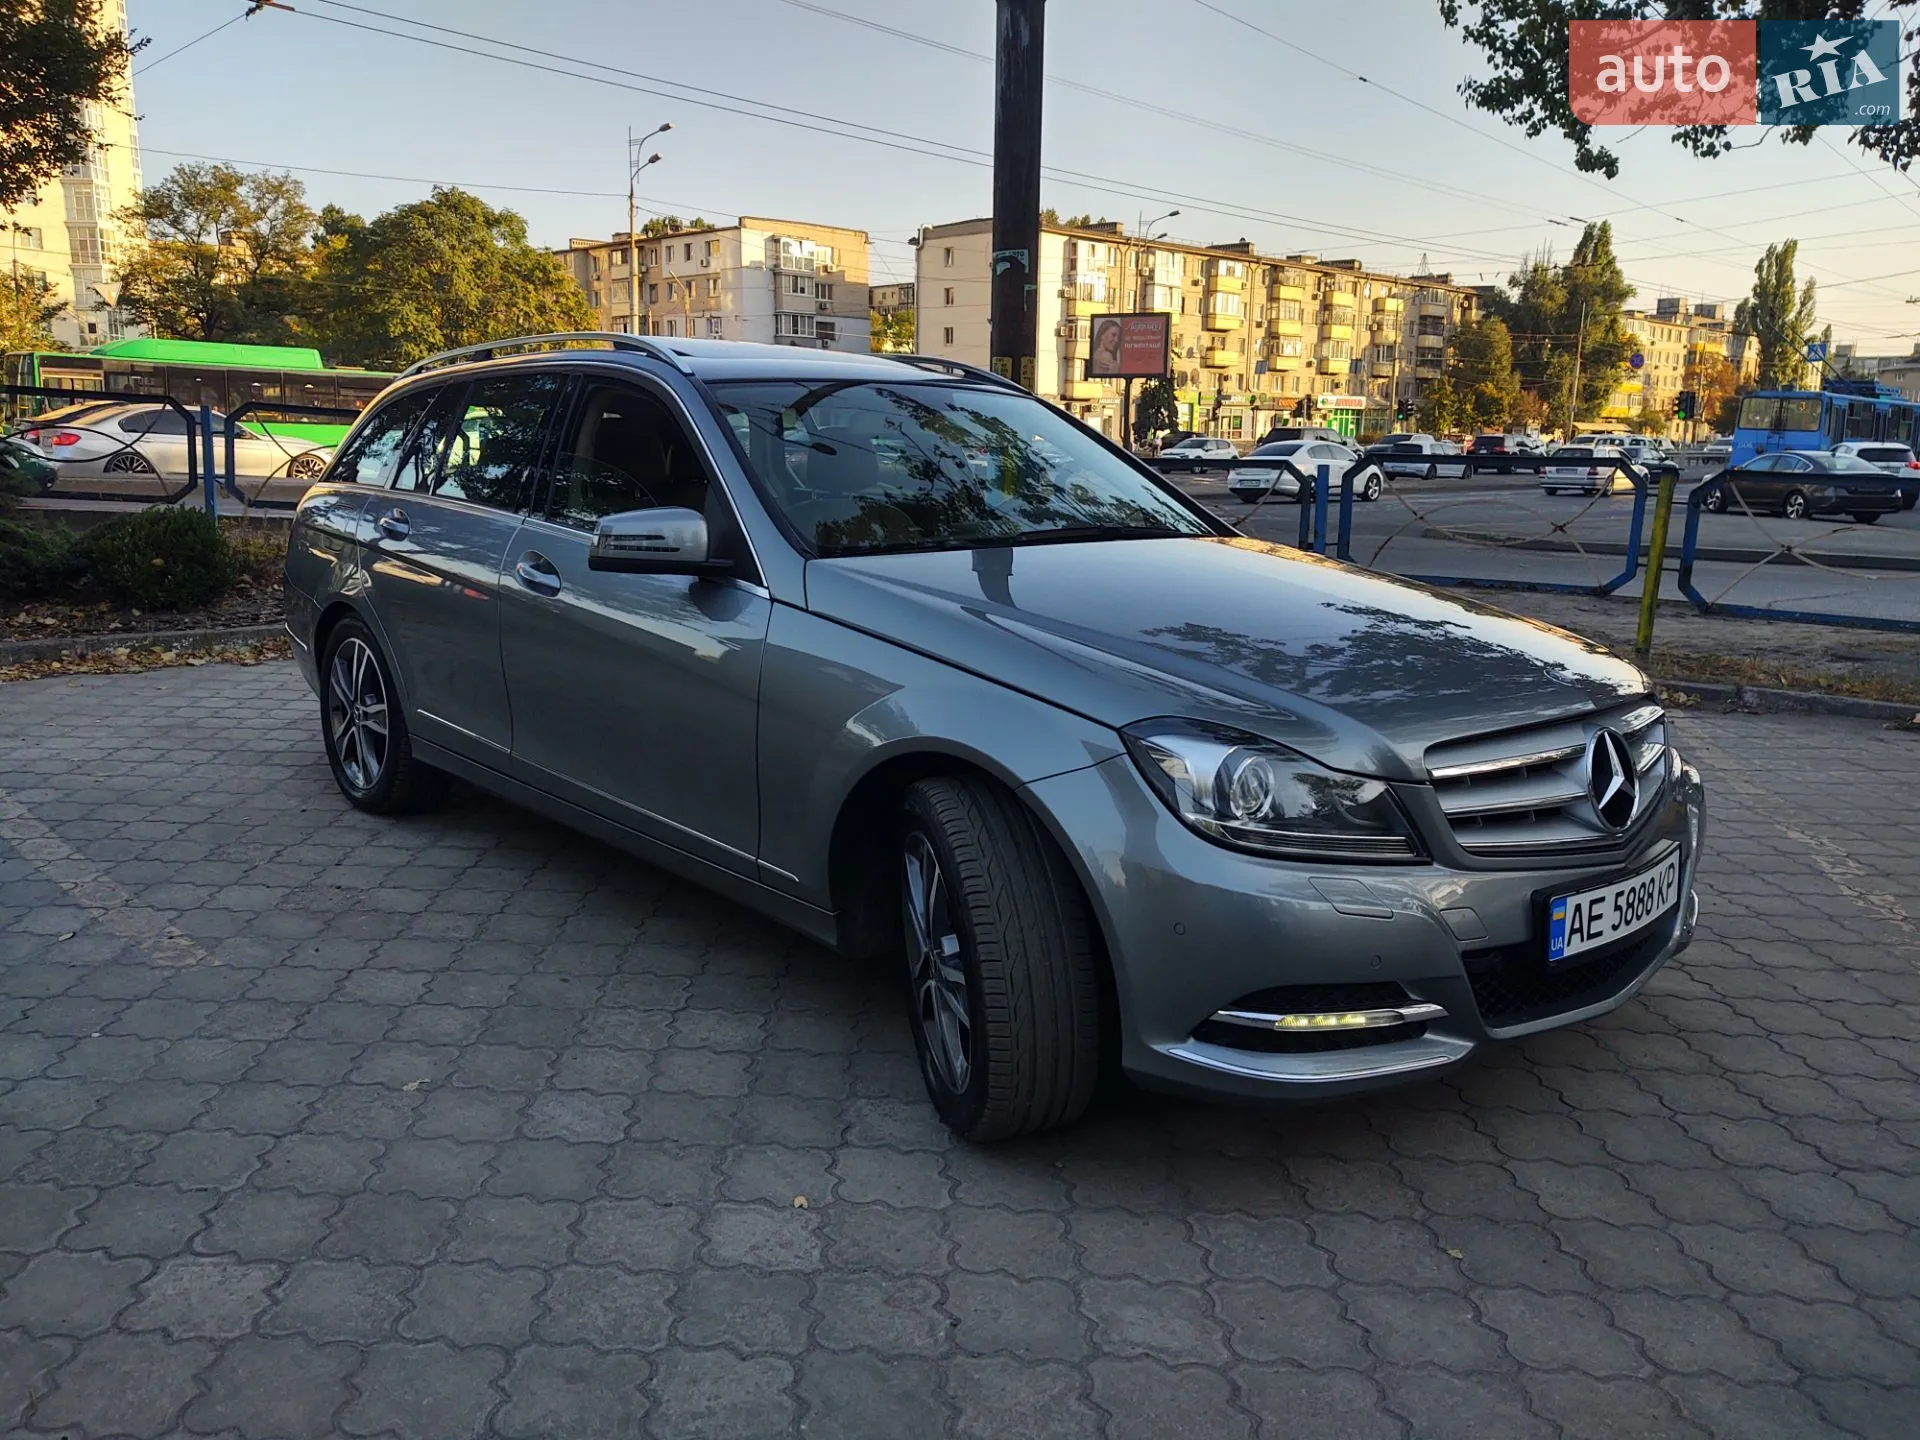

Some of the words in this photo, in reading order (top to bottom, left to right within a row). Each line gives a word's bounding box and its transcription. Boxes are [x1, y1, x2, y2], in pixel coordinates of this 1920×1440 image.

[1566, 896, 1605, 947] AE
[1611, 877, 1655, 931] 5888
[1656, 862, 1675, 910] KP
[1551, 938, 1564, 951] UA
